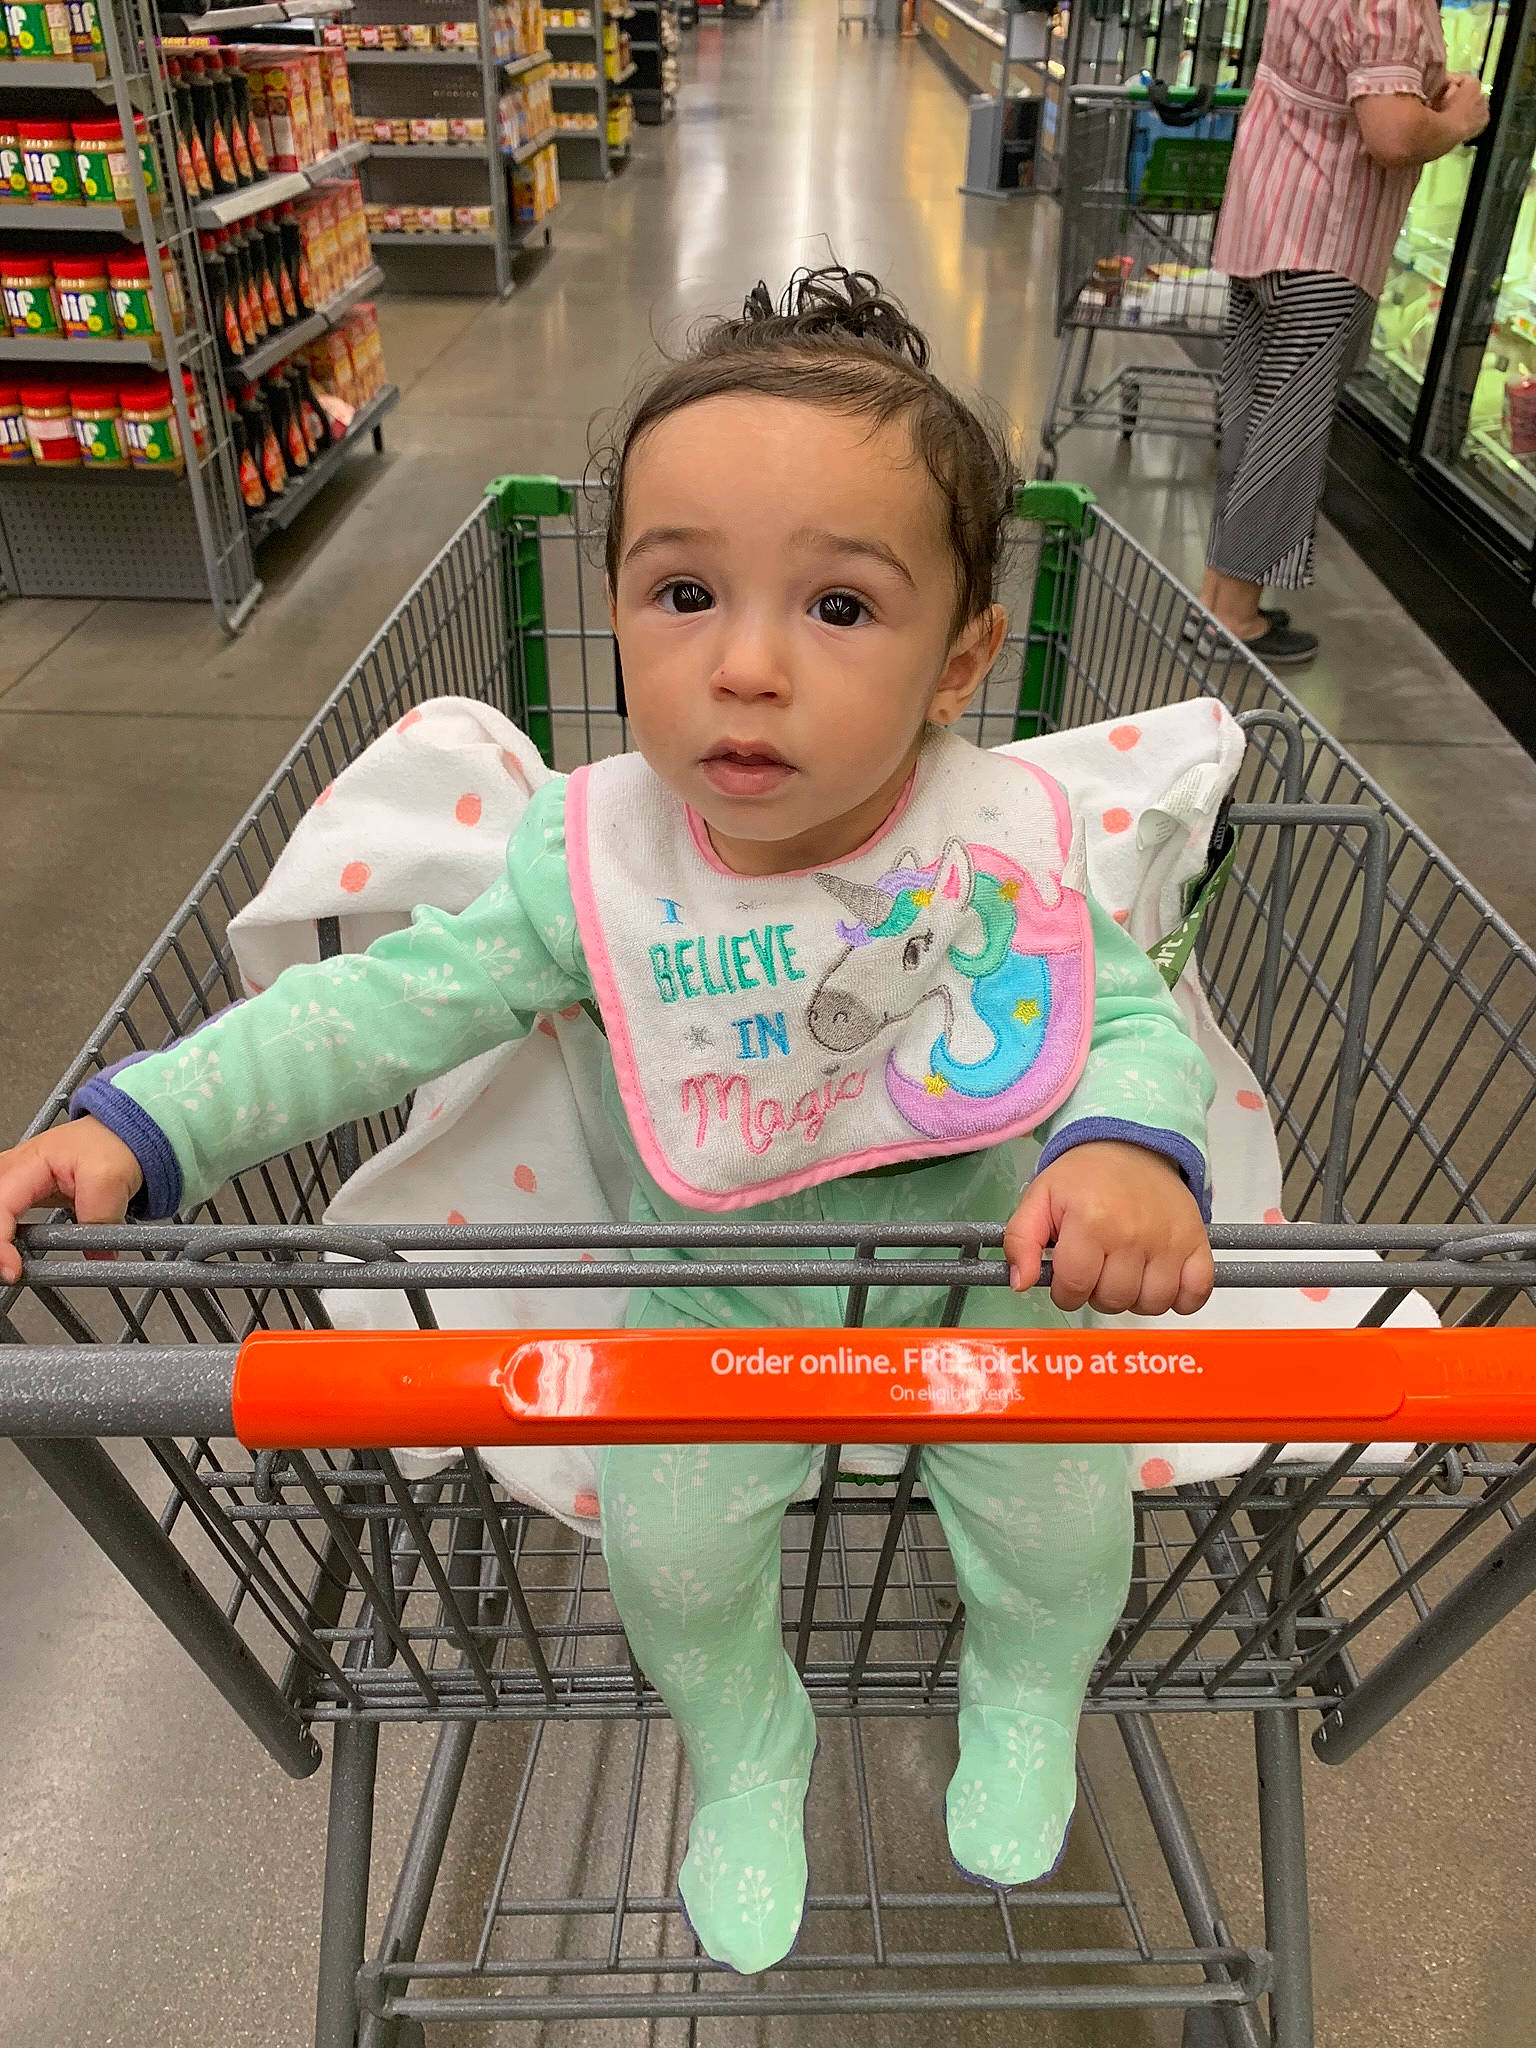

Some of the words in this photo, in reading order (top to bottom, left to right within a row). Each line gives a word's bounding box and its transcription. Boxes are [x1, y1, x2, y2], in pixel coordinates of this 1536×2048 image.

[59, 292, 97, 322] Jif
[656, 897, 685, 925] I
[648, 924, 807, 1004] BELIEVE
[730, 1012, 792, 1060] IN
[681, 1068, 869, 1154] Magic
[711, 1347, 794, 1376] Order
[800, 1346, 897, 1375] online.
[903, 1348, 975, 1375] FRE
[980, 1346, 1040, 1382] pick
[1045, 1354, 1084, 1381] up
[1089, 1351, 1119, 1375] at
[1124, 1350, 1204, 1375] store.
[890, 1384, 915, 1401] On
[917, 1383, 975, 1406] eligibl
